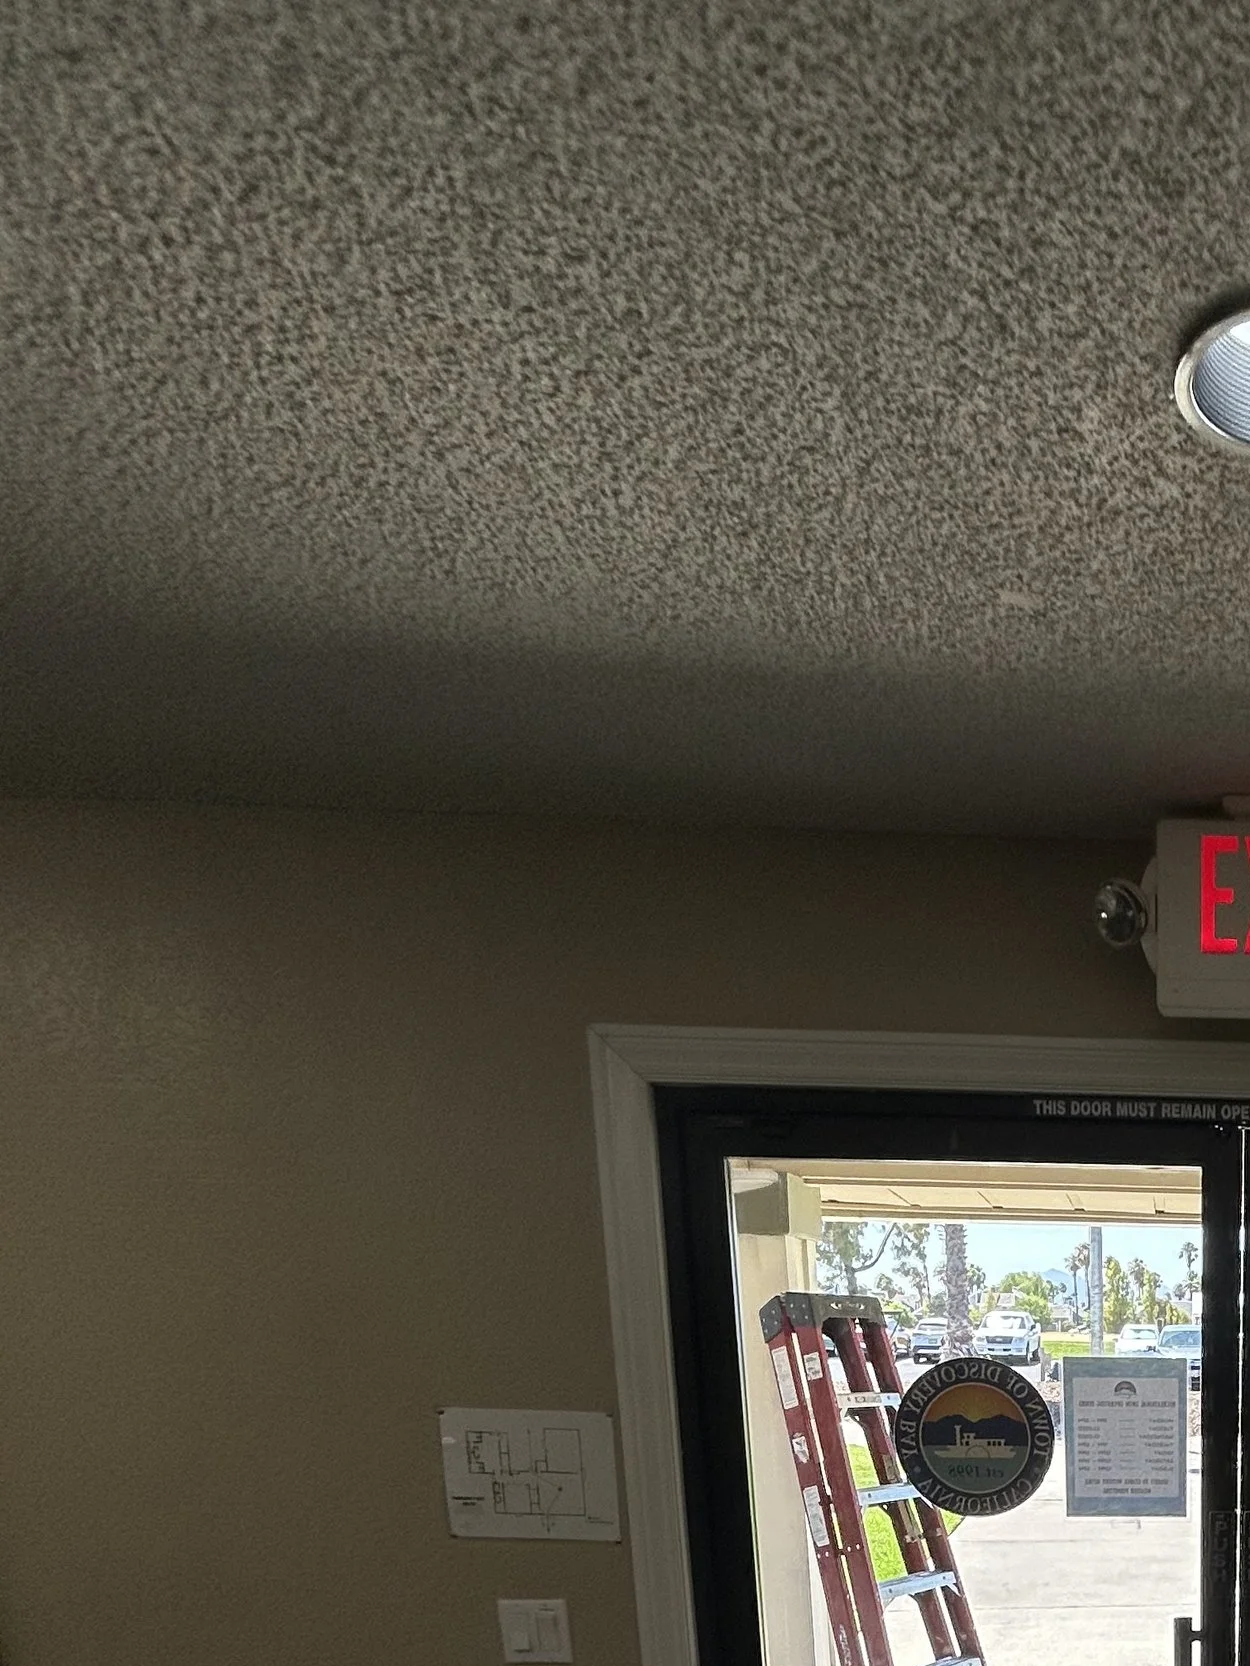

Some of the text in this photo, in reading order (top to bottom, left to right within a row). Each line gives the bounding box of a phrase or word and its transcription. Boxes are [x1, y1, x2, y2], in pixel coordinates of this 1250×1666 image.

[1033, 1099, 1066, 1116] THIS
[1070, 1100, 1112, 1117] DOOR
[1116, 1101, 1157, 1118] MUST
[1161, 1102, 1217, 1119] REMAIN
[1212, 1520, 1229, 1582] PUSH
